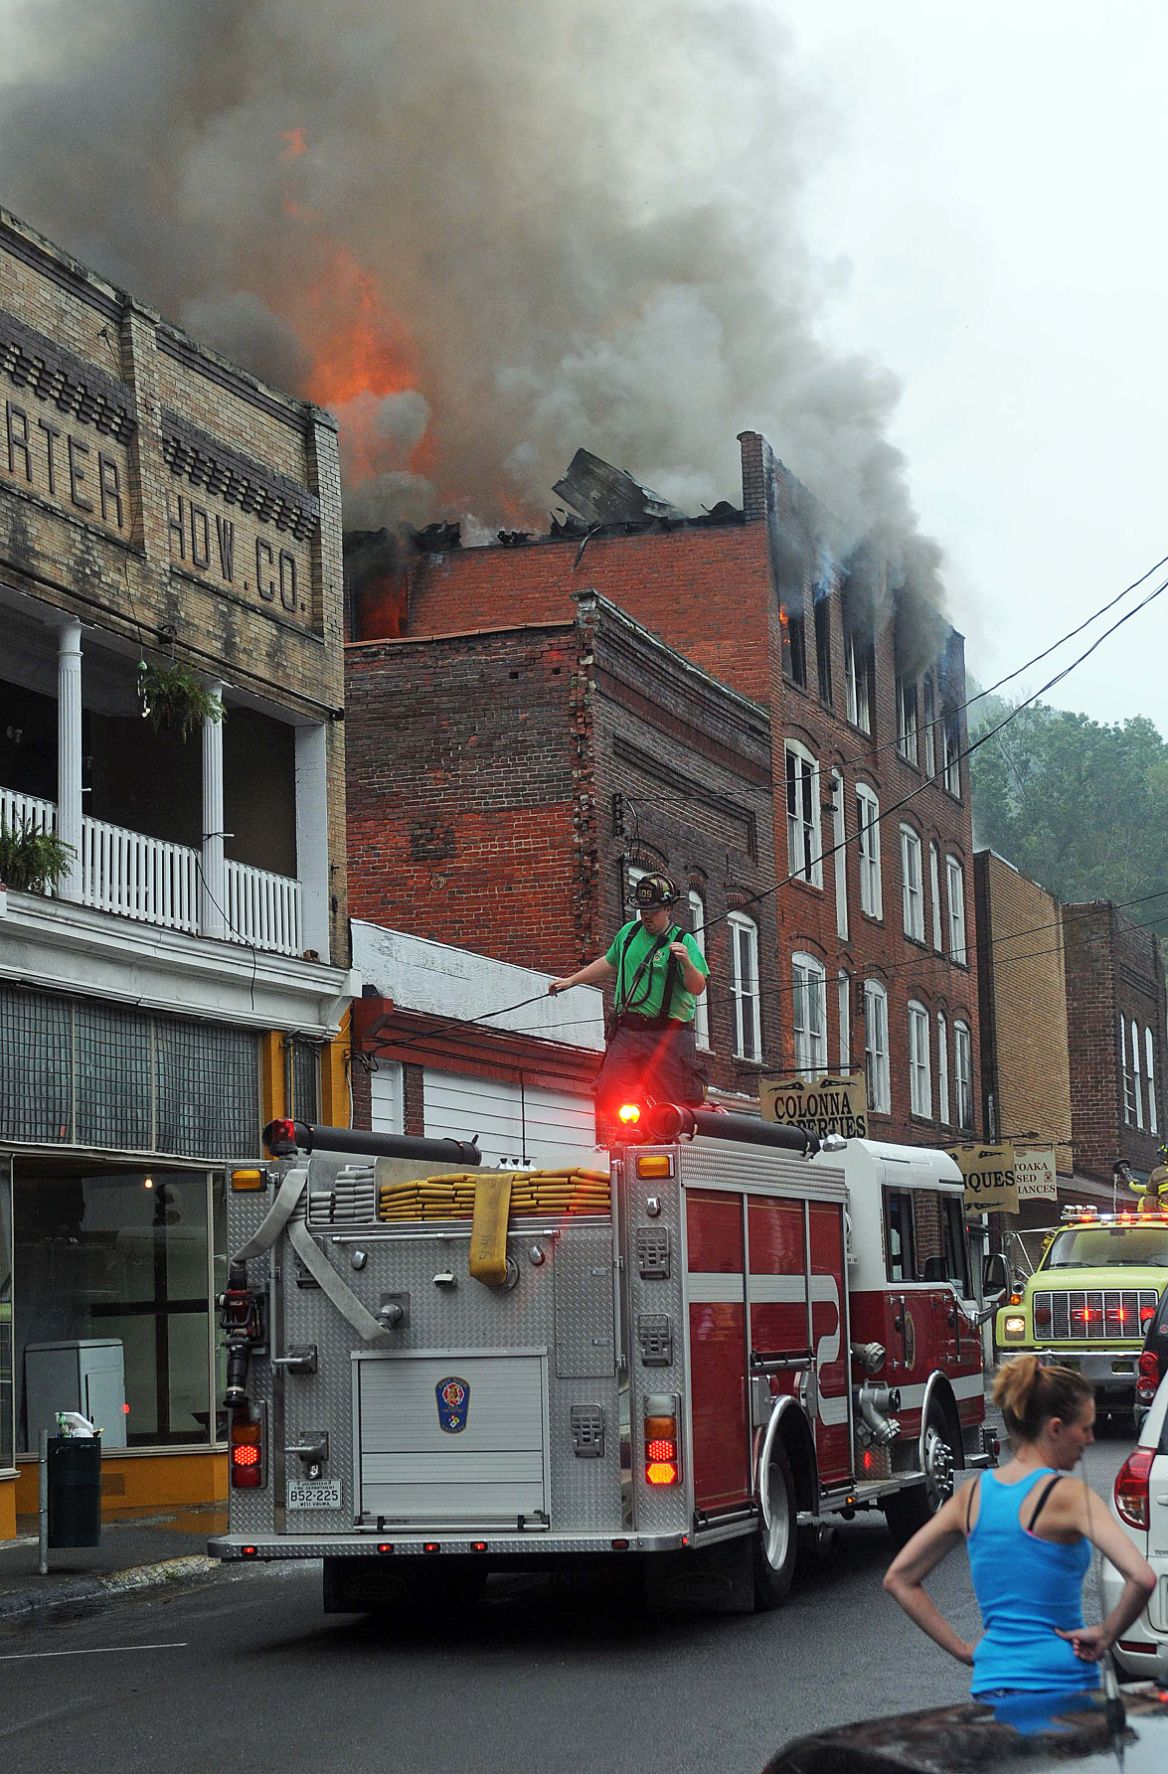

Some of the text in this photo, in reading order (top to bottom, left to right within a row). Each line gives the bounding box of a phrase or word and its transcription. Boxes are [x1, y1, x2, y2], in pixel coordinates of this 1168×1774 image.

[256, 536, 305, 612] CO.
[774, 1091, 852, 1120] COLONNA
[773, 1115, 866, 1140] PERTIES
[290, 1490, 339, 1501] B52-225
